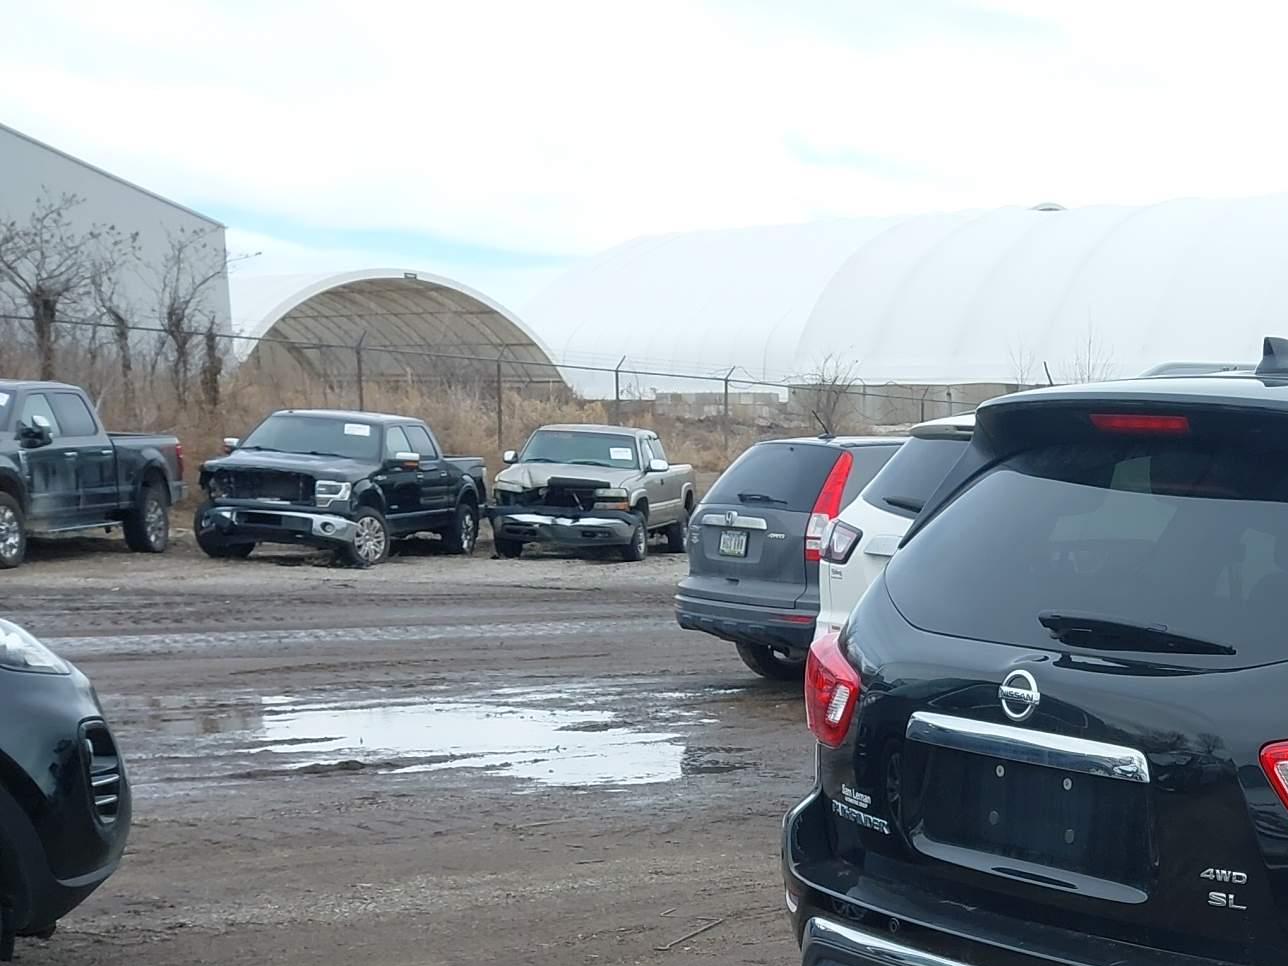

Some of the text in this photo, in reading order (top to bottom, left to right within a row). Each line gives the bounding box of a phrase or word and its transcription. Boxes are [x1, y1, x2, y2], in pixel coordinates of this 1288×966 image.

[1000, 687, 1035, 702] NISSAN
[1199, 867, 1248, 885] 4WD
[1207, 891, 1248, 910] SL
